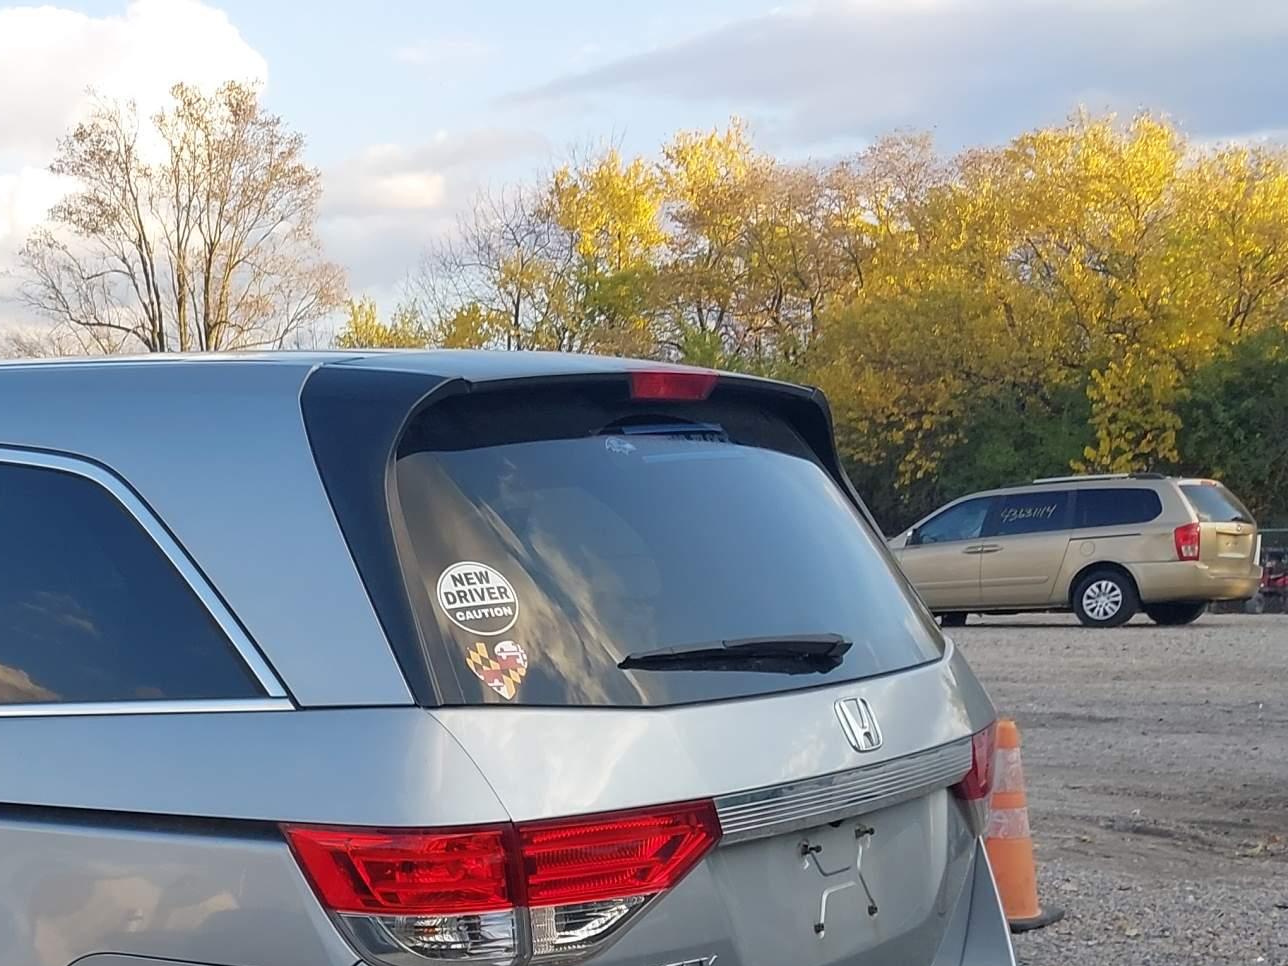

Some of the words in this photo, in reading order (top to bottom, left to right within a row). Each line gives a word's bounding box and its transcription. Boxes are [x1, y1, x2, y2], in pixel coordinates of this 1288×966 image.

[450, 570, 491, 587] NEW
[443, 585, 511, 606] DRIVER
[455, 606, 513, 621] CAUTION
